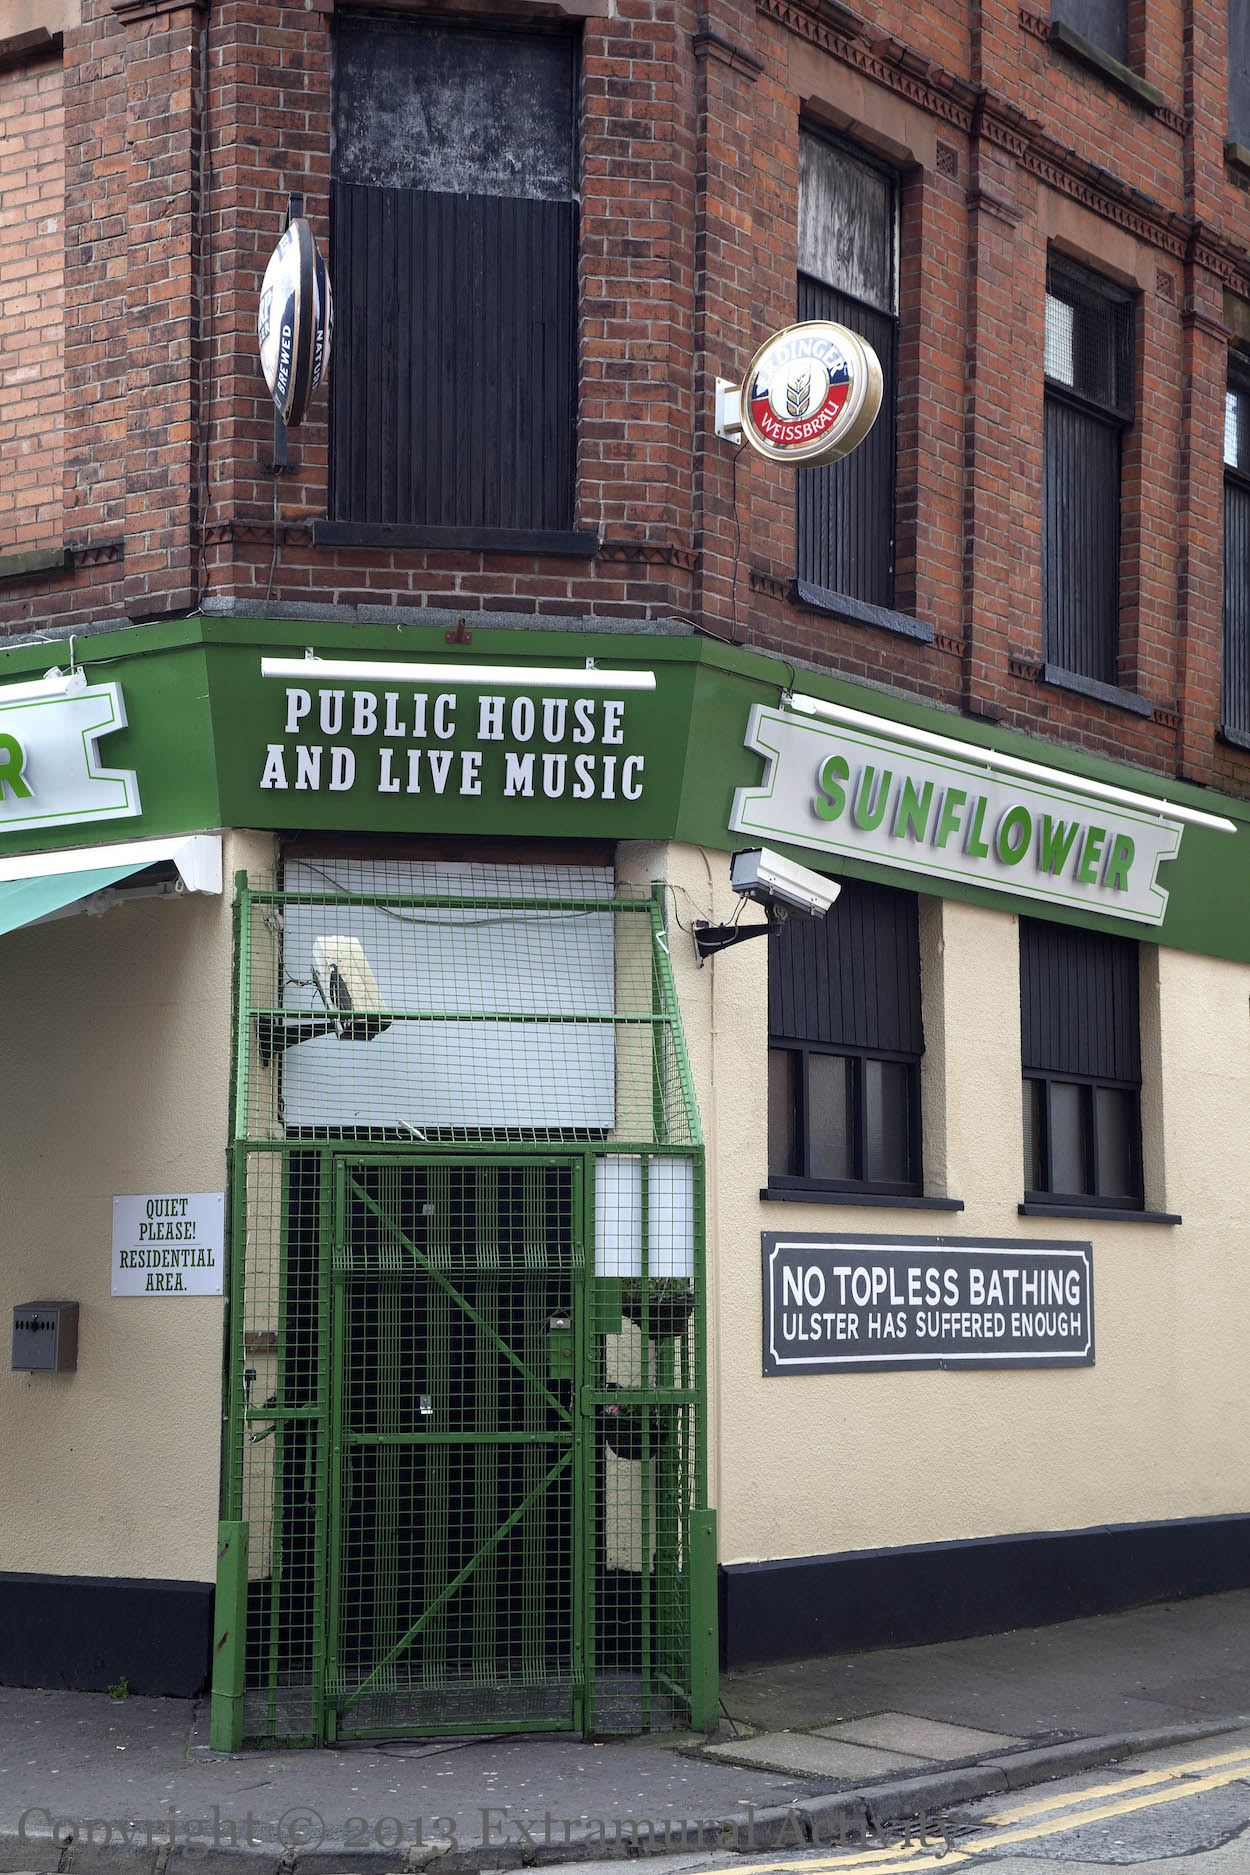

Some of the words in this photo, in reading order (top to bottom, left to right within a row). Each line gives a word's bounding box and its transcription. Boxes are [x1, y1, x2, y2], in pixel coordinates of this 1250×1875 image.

[277, 324, 292, 396] BREWED
[761, 400, 839, 441] WEISSBRÄU
[285, 688, 457, 739] PUBLIC
[477, 696, 625, 744] HOUSE
[260, 744, 357, 791] AND
[378, 748, 483, 795] LIVE
[504, 752, 645, 800] MUSIC
[815, 754, 1135, 892] SUNFLOWER
[146, 1198, 189, 1220] QUIET
[139, 1221, 196, 1241] PLEASE!
[119, 1248, 215, 1269] RESIDENTIAL
[145, 1272, 188, 1292] AREA.
[783, 1265, 826, 1306] NO
[833, 1265, 960, 1307] TOPLESS
[969, 1268, 1081, 1306] BATHING
[783, 1312, 859, 1341] ULSTER
[868, 1311, 907, 1339] HAS
[915, 1311, 1006, 1338] SUFFERED
[1011, 1312, 1082, 1337] ENOUGH
